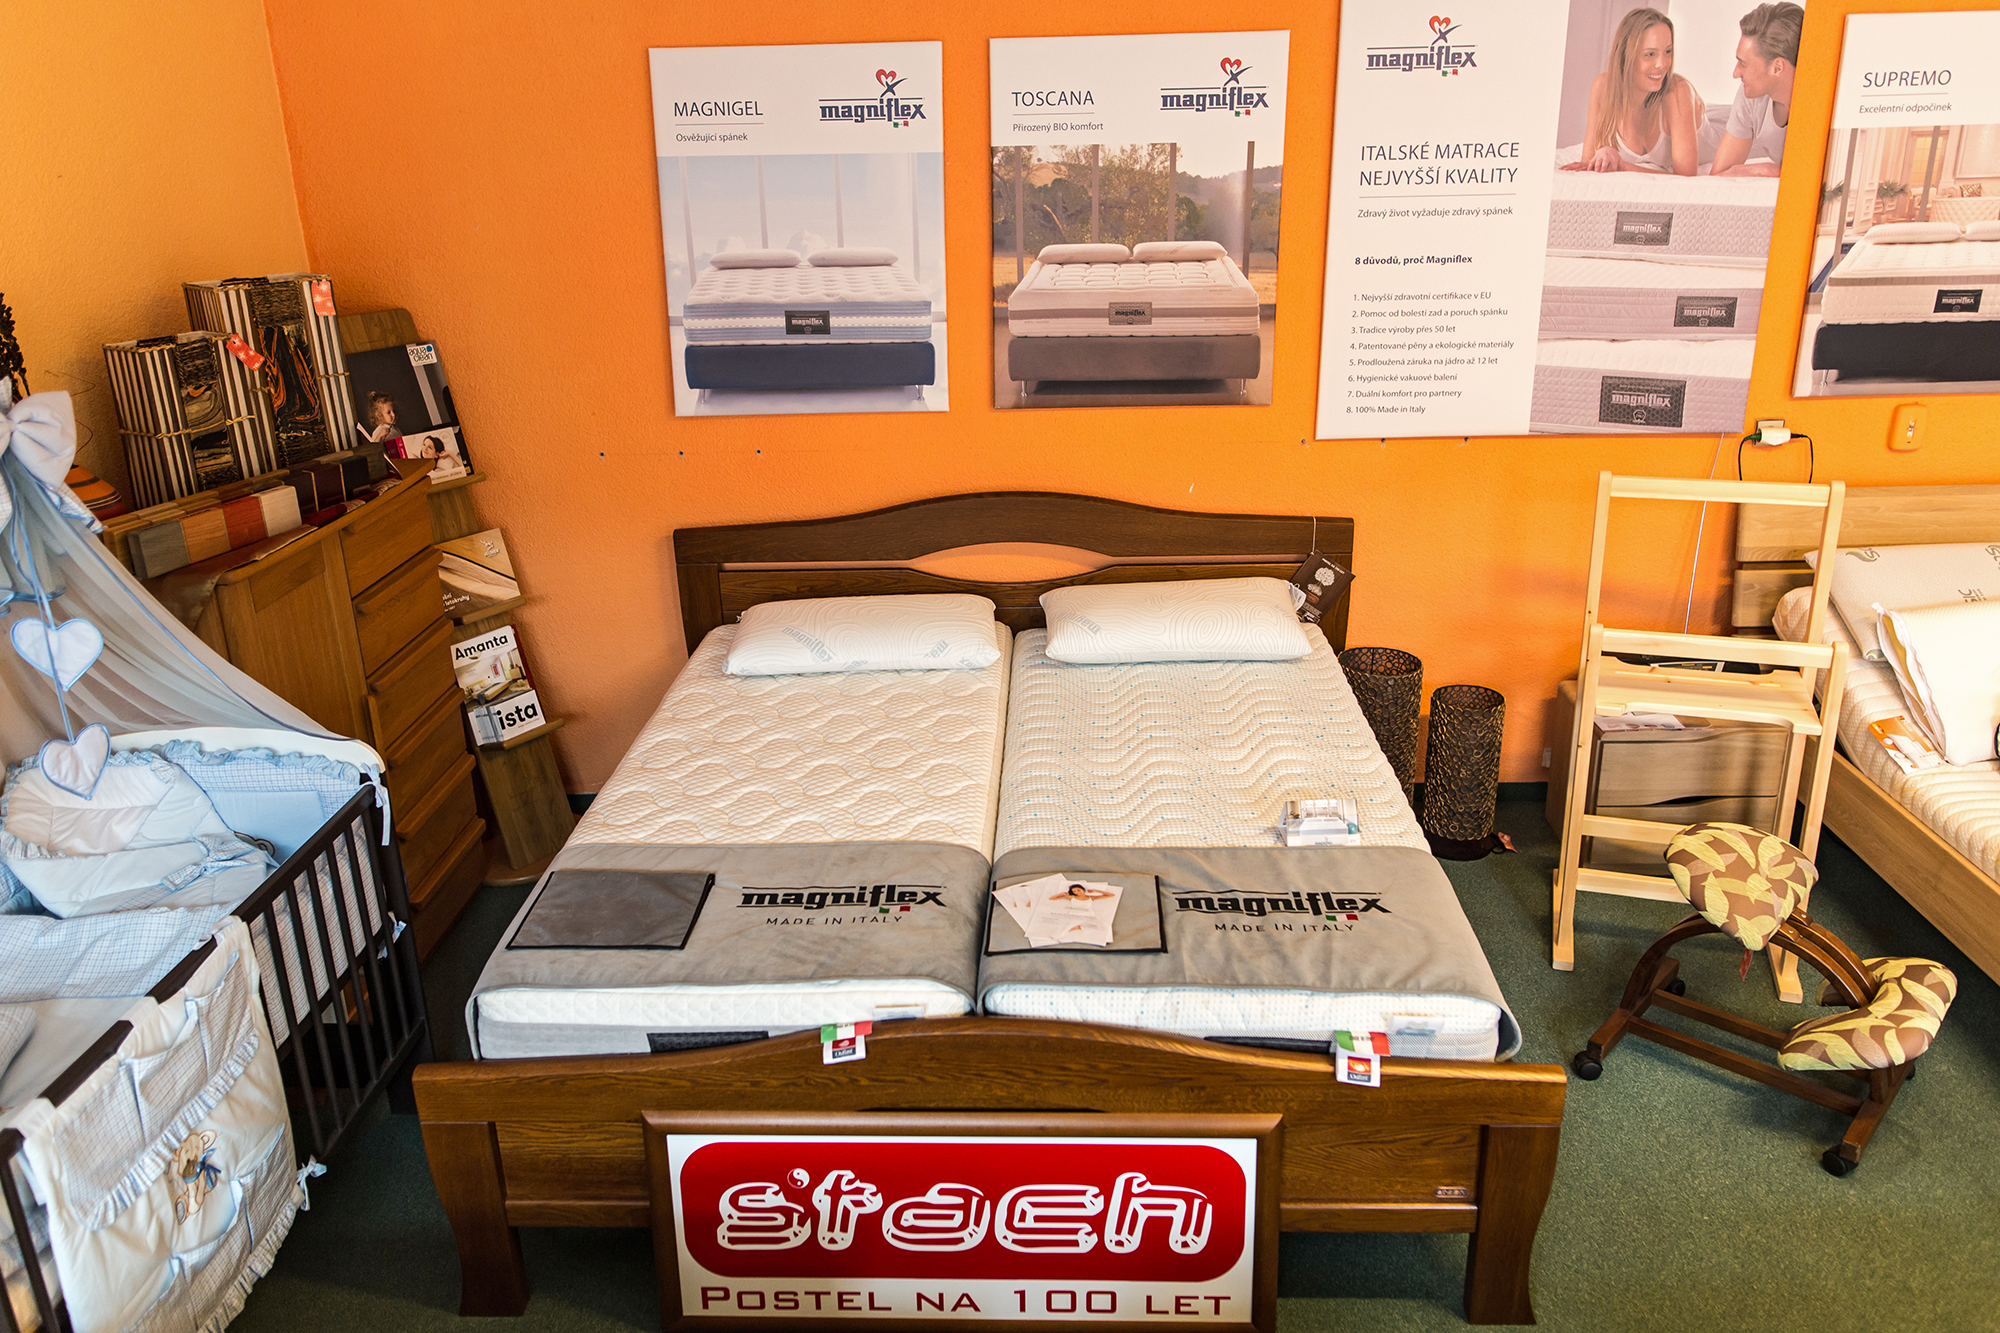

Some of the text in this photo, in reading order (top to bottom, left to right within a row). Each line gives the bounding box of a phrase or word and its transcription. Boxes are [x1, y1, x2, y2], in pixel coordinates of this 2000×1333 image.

[1366, 45, 1478, 72] magniflex
[1862, 69, 1952, 88] SUPREMO
[1011, 90, 1095, 107] TOSCANA
[1160, 87, 1270, 112] magniflex
[673, 100, 764, 117] MAGNIGEL
[819, 97, 927, 123] magniflex
[1858, 103, 1953, 115] Excelentní odpočinek
[1012, 122, 1104, 134] Přirozený BIO komfort
[675, 132, 748, 144] Osvěžující spánek
[1361, 141, 1520, 161] ITALSKÉ MATRACE
[1359, 166, 1518, 186] NEJVYŠŠÍ KVALITY
[1357, 206, 1514, 219] Zdravý život vyžaduje zdravý spánek
[1354, 255, 1473, 266] 8 důvodů, proč Magniflex
[1353, 294, 1360, 302] 1.
[1361, 293, 1393, 303] Nejvyšší
[1394, 292, 1431, 301] zdravotní
[1432, 292, 1472, 300] certifikace
[1480, 292, 1492, 300] EU
[1351, 310, 1359, 318] 2.
[1360, 310, 1387, 318] Pomoc
[1388, 309, 1399, 317] od
[1400, 309, 1427, 317] bolestí
[1428, 308, 1443, 316] zad
[1450, 308, 1478, 318] poruch
[1479, 308, 1508, 318] spánku
[1351, 325, 1456, 335] 3. Tradice výroby přes 50 let
[1358, 342, 1407, 350] Patentované
[1408, 342, 1428, 351] pěny
[1434, 341, 1477, 350] ekologické
[1478, 341, 1515, 350] materiály
[1349, 359, 1356, 367] 5.
[1357, 358, 1405, 366] Prodloužená
[1406, 357, 1432, 366] záruka
[1444, 357, 1465, 366] jádro
[1466, 357, 1476, 365] až
[1477, 357, 1487, 365] 12
[1487, 356, 1498, 365] let
[1347, 373, 1458, 384] 6. Hygienické vakuové balení
[1347, 389, 1463, 399] 7. Duální komfort pro partnery
[1346, 405, 1426, 415] 8. 100% Made in Italy
[455, 634, 509, 661] Amanta
[738, 884, 948, 910] magniflex
[1174, 892, 1391, 918] magniflex
[766, 915, 903, 926] MADE IN ITALY
[1214, 922, 1355, 934] MADE IN ITALY
[701, 1286, 1232, 1317] POSTEL NA 100 LET
